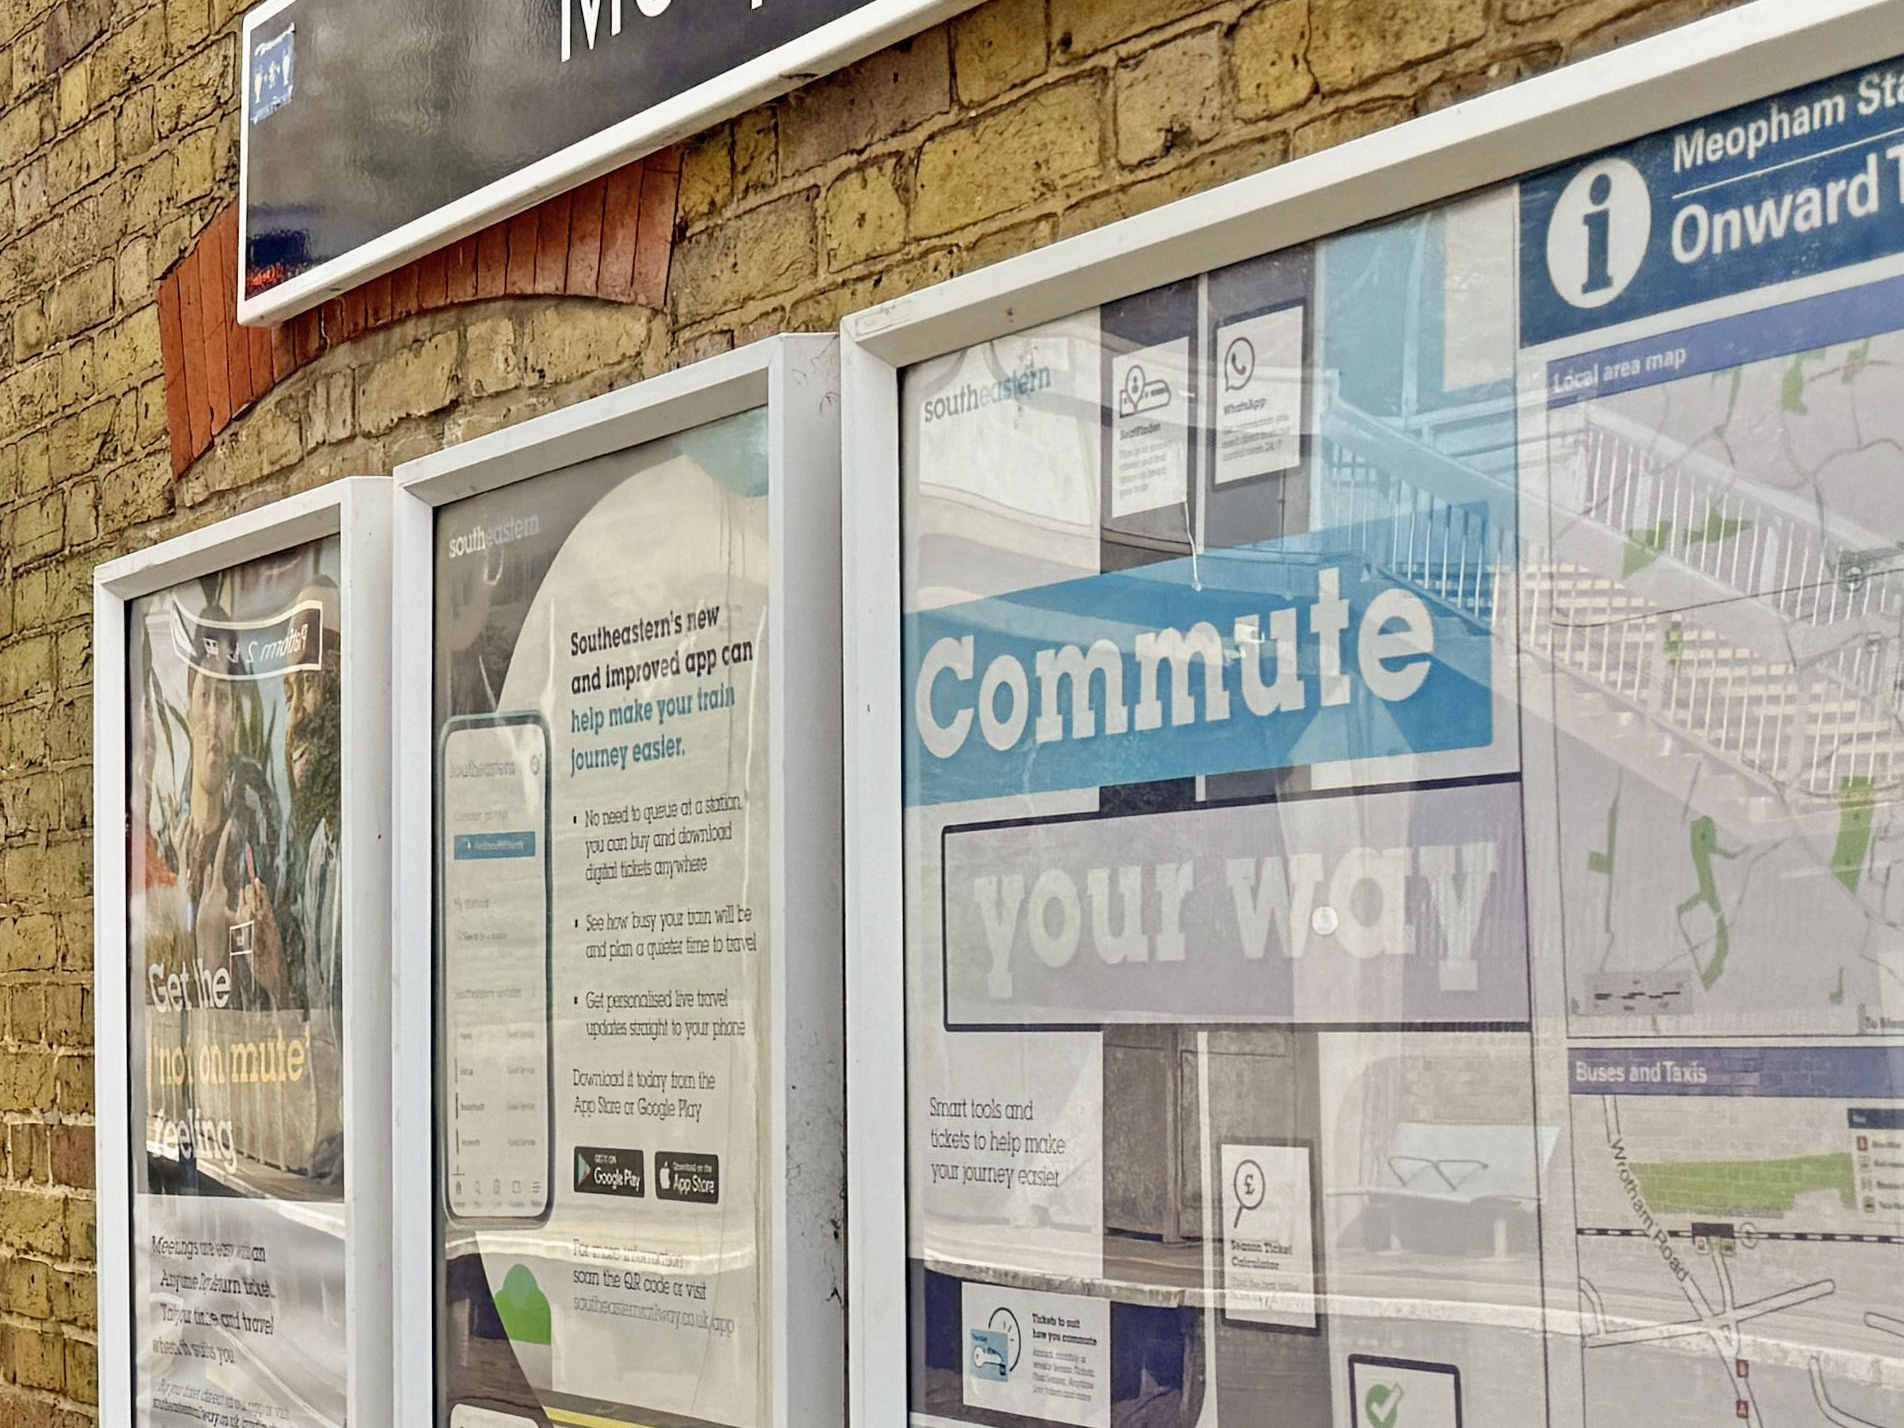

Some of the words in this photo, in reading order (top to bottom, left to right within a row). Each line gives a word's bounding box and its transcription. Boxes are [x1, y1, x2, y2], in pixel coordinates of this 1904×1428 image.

[1673, 93, 1846, 173] Meopham
[1672, 152, 1879, 264] Onward
[1603, 358, 1641, 382] area
[1646, 347, 1686, 374] map
[924, 366, 1051, 422] southeastern
[449, 515, 540, 558] southeastern
[571, 610, 682, 656] Southeastern's
[687, 606, 720, 632] new
[572, 666, 601, 694] and
[606, 650, 680, 690] improved
[685, 647, 716, 677] app
[722, 641, 753, 665] can
[915, 566, 1433, 760] Commute
[571, 707, 604, 735] help
[609, 699, 653, 727] make
[657, 695, 692, 724] your
[697, 682, 735, 712] train
[571, 744, 628, 778] journey
[632, 734, 685, 762] easier.
[585, 810, 599, 827] No
[603, 806, 628, 825] need
[631, 805, 640, 821] to
[644, 803, 677, 823] queue
[681, 798, 692, 815] at
[695, 801, 703, 814] a
[585, 840, 603, 859] you
[607, 837, 627, 851] can
[631, 831, 649, 852] buy
[653, 828, 675, 846] and
[678, 821, 732, 844] download
[586, 861, 617, 884] digital
[621, 858, 651, 877] tickets
[586, 915, 603, 931] See
[607, 913, 628, 929] how
[632, 912, 656, 932] busy
[660, 913, 683, 932] your
[688, 908, 711, 924] train
[715, 905, 734, 923] will
[738, 905, 752, 922] be
[973, 851, 1194, 999] your
[1226, 841, 1497, 991] way
[586, 942, 606, 958] and
[610, 940, 633, 961] plan
[636, 944, 644, 956] a
[648, 938, 683, 960] quieter
[687, 936, 709, 953] time
[713, 936, 722, 952] to
[726, 933, 757, 951] travel
[149, 961, 192, 1013] Get
[586, 992, 603, 1008] Get
[607, 990, 671, 1013] personalised
[675, 990, 694, 1007] live
[697, 988, 728, 1007] travel
[586, 1020, 626, 1040] updates
[630, 1019, 668, 1040] straight
[672, 1019, 681, 1036] to
[685, 1021, 709, 1040] your
[713, 1018, 745, 1040] phone
[199, 1044, 225, 1085] on
[573, 1069, 624, 1087] Download
[628, 1070, 634, 1087] it
[637, 1070, 667, 1092] today
[671, 1072, 695, 1088] from
[699, 1072, 715, 1089] the
[1576, 1061, 1625, 1082] Buses
[1630, 1062, 1661, 1082] and
[1662, 1061, 1707, 1083] Taxis
[574, 1096, 595, 1117] App
[598, 1097, 621, 1115] Store
[624, 1102, 634, 1115] or
[638, 1098, 675, 1120] Google
[678, 1099, 702, 1123] Play
[930, 1097, 967, 1117] Smart
[971, 1099, 1001, 1119] tools
[1005, 1101, 1033, 1120] and
[153, 1108, 237, 1174] feeling
[931, 1128, 970, 1150] tickets
[974, 1131, 986, 1150] to
[991, 1131, 1021, 1157] help
[1025, 1134, 1065, 1154] make
[594, 1167, 623, 1189] Google
[624, 1168, 640, 1191] Play
[673, 1174, 691, 1194] App
[693, 1175, 714, 1193] Store
[931, 1164, 958, 1183] your
[962, 1162, 1014, 1189] journey
[1611, 1138, 1654, 1230] Wrotham
[1654, 1229, 1689, 1282] Road
[574, 1270, 599, 1285] scan
[603, 1269, 620, 1288] the
[624, 1272, 640, 1290] QR
[644, 1276, 670, 1295] code
[673, 1283, 682, 1296] or
[686, 1282, 706, 1300] visit
[242, 1312, 274, 1335] travel
